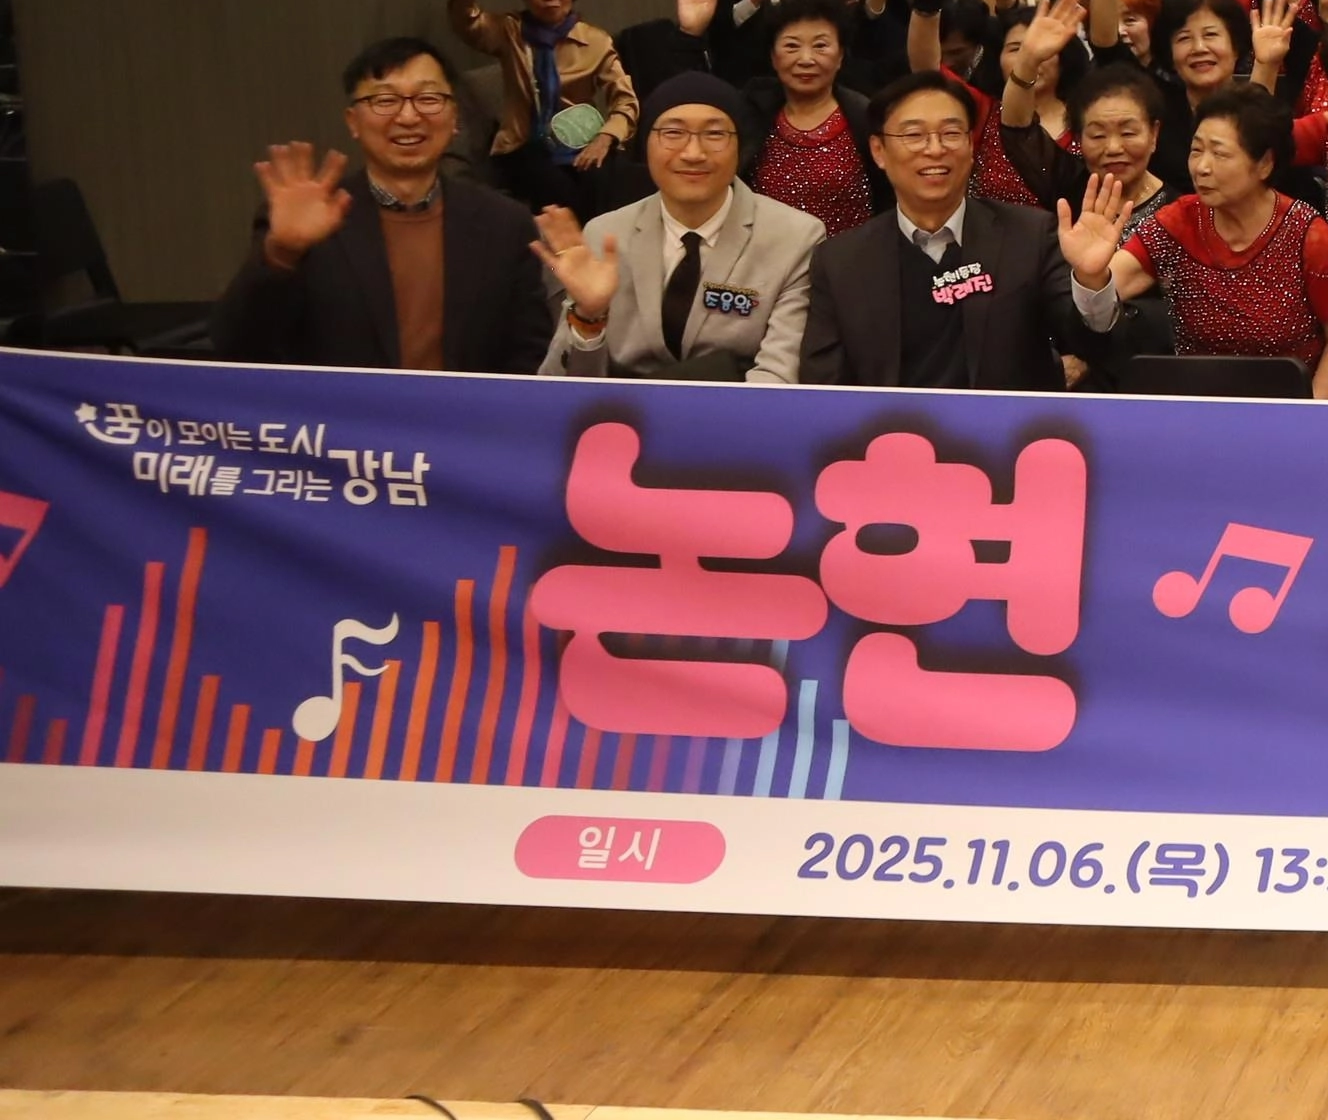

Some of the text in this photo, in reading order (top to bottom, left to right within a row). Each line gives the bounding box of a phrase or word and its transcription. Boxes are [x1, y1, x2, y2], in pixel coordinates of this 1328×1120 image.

[96, 402, 326, 458] 꿈이 모이는 도시
[132, 449, 431, 507] 미래를 그리는 강남
[530, 421, 1088, 752] 논현
[576, 826, 663, 871] 일시
[797, 831, 1231, 898] 2025.11.06.(목)
